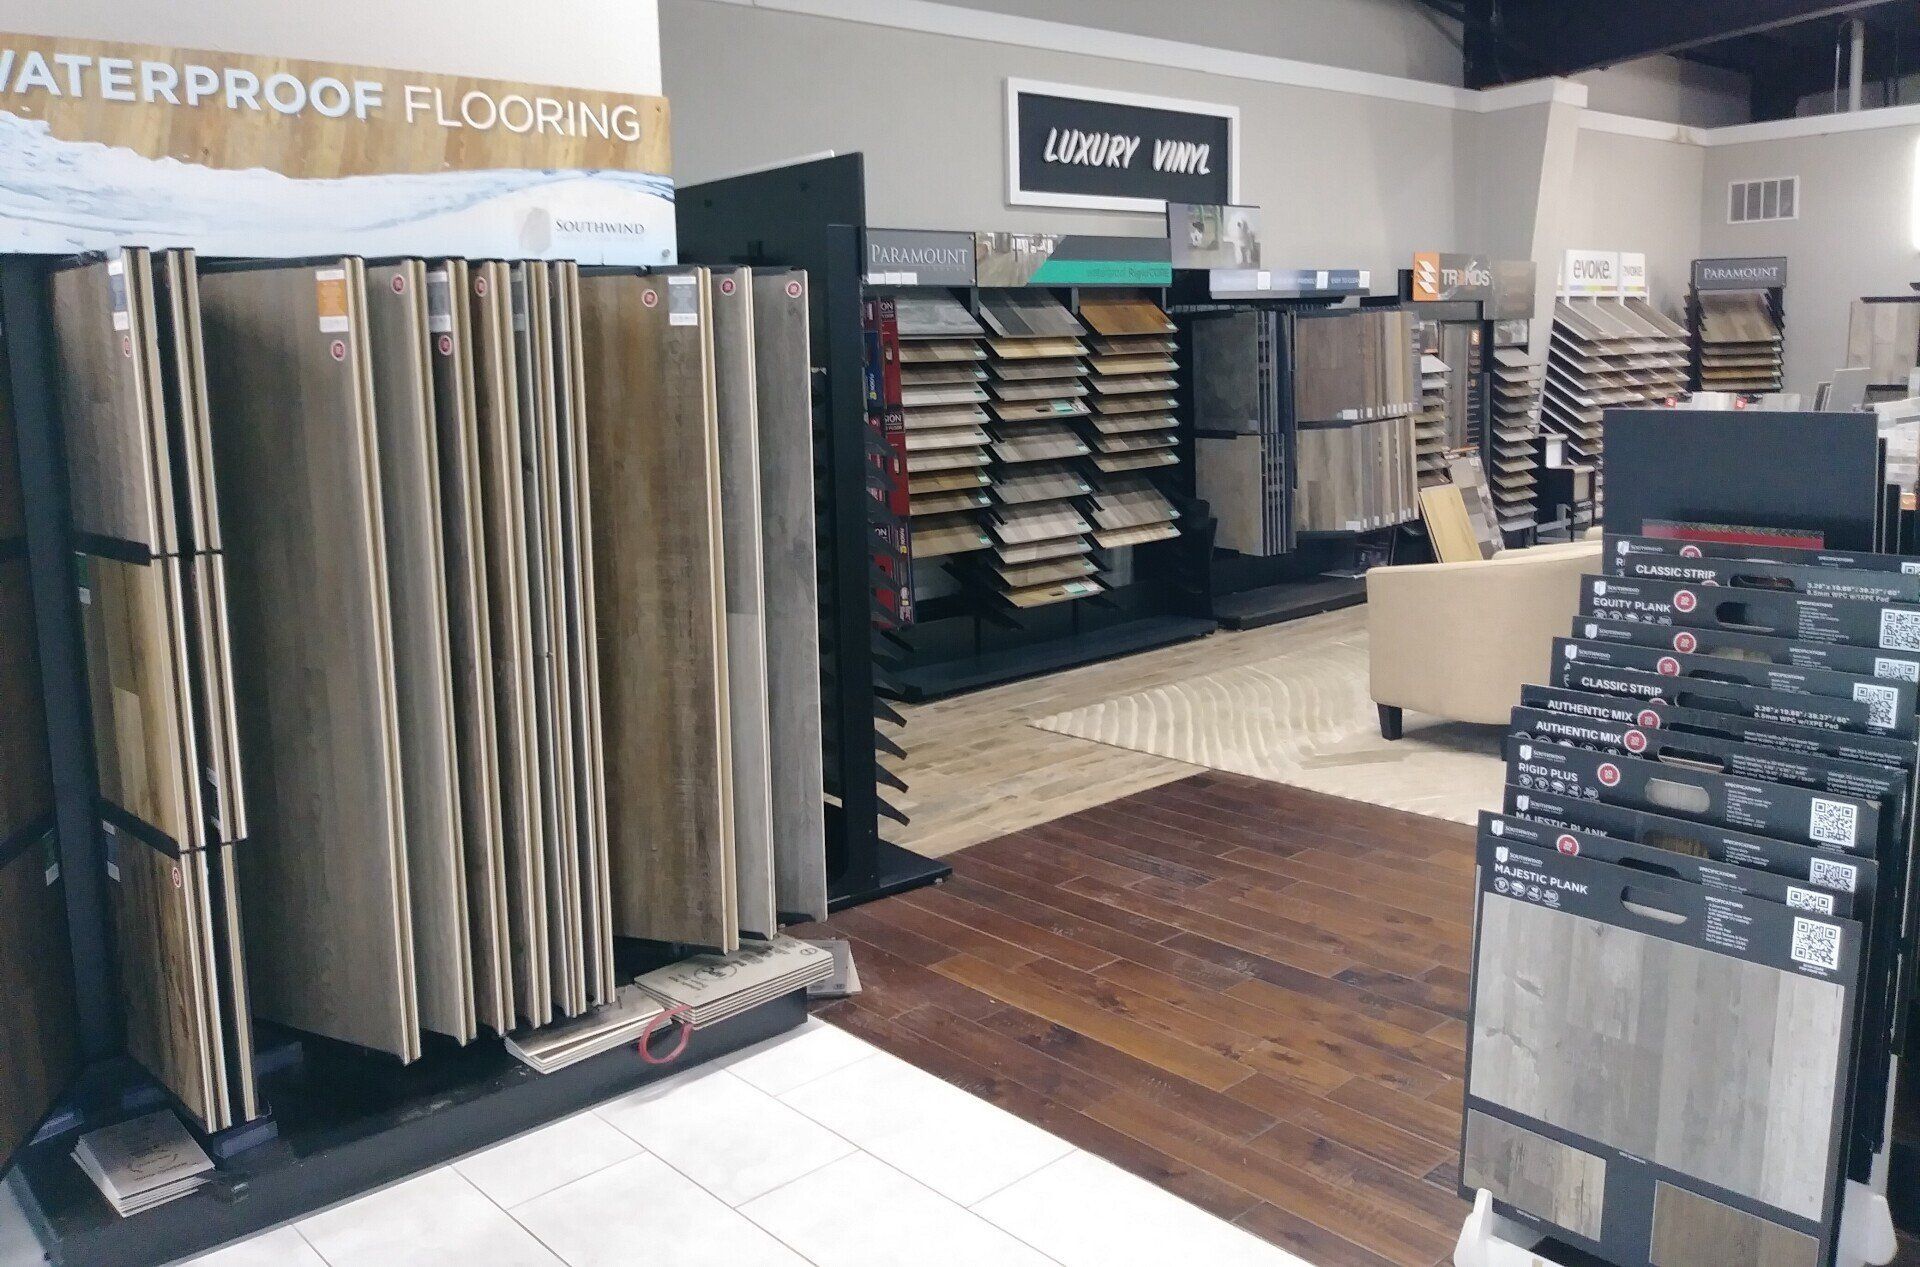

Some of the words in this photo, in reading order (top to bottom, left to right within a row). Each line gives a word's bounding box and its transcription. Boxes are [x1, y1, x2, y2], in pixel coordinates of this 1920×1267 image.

[404, 84, 642, 142] FLOORING
[1043, 126, 1141, 169] LUXURY
[1152, 138, 1211, 175] VINYL
[555, 219, 645, 235] SOUTHWIND
[871, 244, 968, 264] PARAMOUNT
[1703, 266, 1778, 279] PARAMOUNT
[1635, 564, 1682, 577] CLASSIC
[1683, 568, 1717, 580] STRIP
[1593, 597, 1632, 609] EQUITY
[1635, 601, 1672, 613] PLANK
[1581, 677, 1628, 692] CLASSIC
[1630, 683, 1663, 697] STRIP
[1547, 700, 1611, 718] AUTHENTIC
[1611, 710, 1634, 722] MIX
[1535, 721, 1599, 740] AUTHENTIC
[1600, 730, 1622, 744] MIX
[1825, 722, 1839, 730] Pad
[1518, 762, 1548, 776] RIGID
[1550, 769, 1579, 782] PLUS
[1494, 862, 1548, 884] MAJESTIC
[1550, 877, 1589, 895] PLANK
